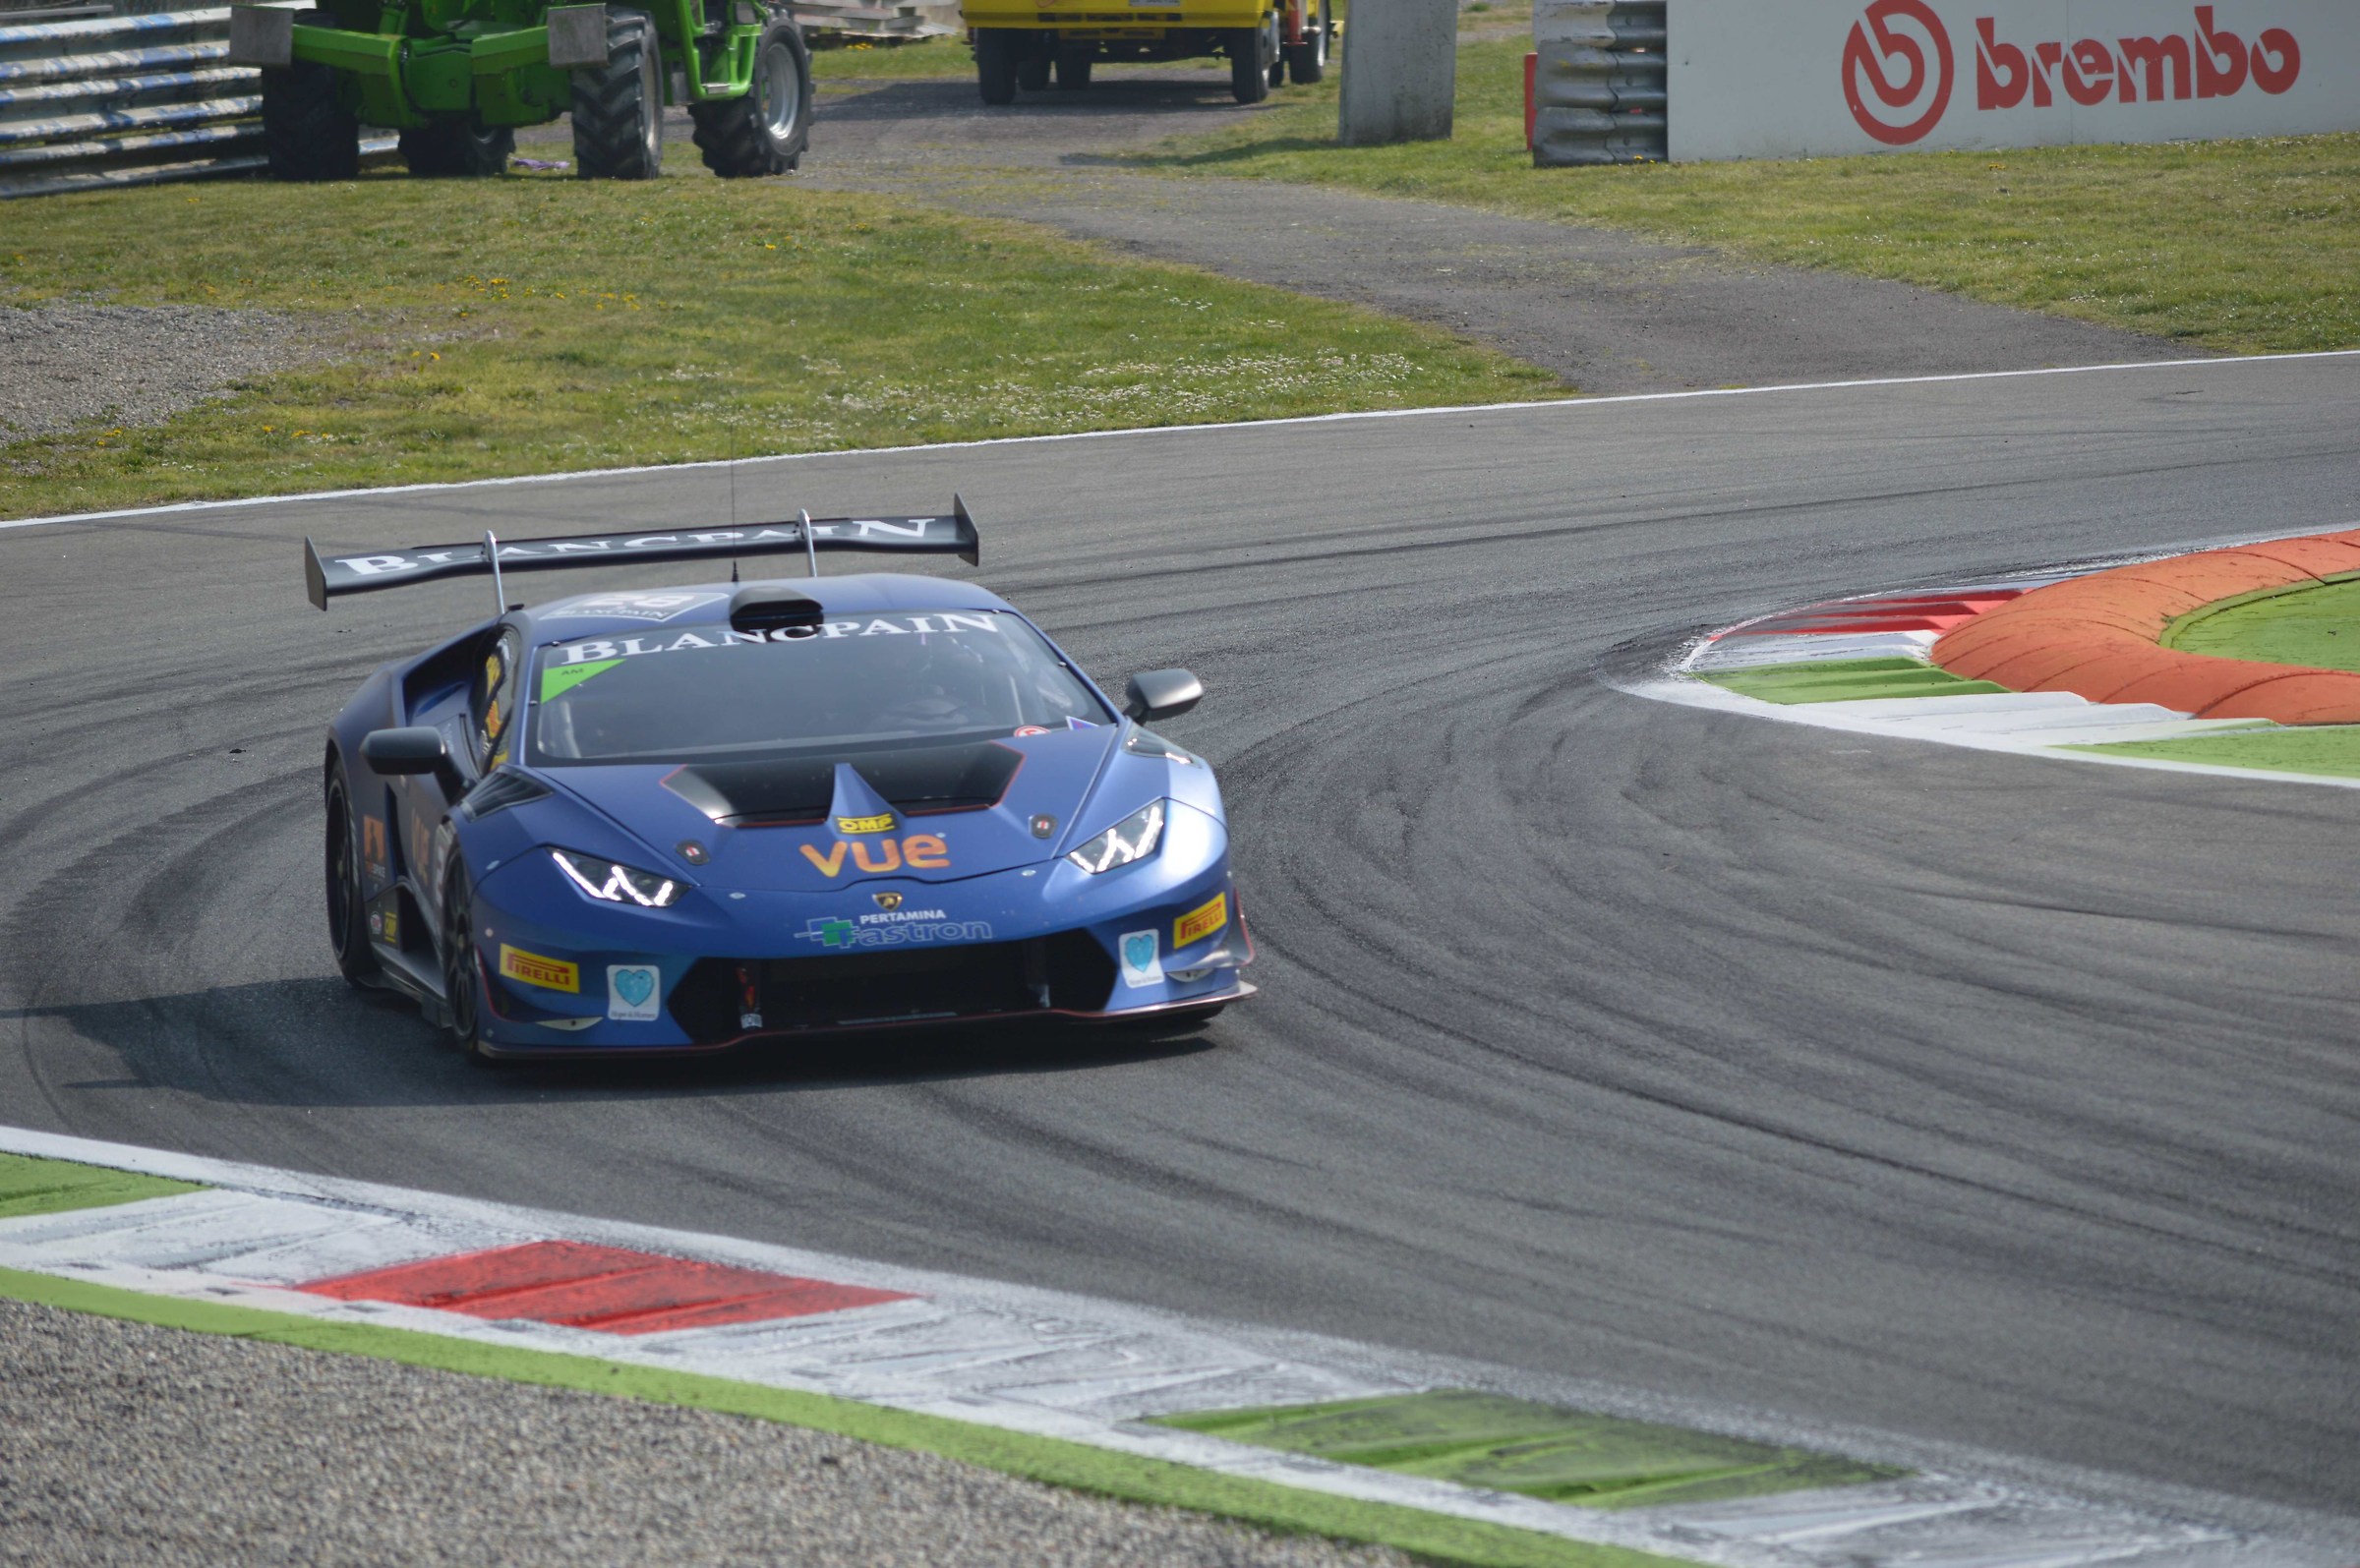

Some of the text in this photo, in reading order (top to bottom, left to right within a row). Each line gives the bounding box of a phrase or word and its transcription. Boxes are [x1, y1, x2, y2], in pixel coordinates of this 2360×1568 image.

[1976, 5, 2301, 110] brembo
[334, 517, 936, 577] BLANCPAIN
[560, 612, 999, 666] BLANCPAIN
[560, 668, 585, 676] AM
[839, 816, 894, 832] OMP
[798, 834, 951, 878] vue
[859, 909, 947, 925] PERTAMINA
[1181, 900, 1223, 940] PIRELLI
[506, 952, 571, 987] PIRELLI
